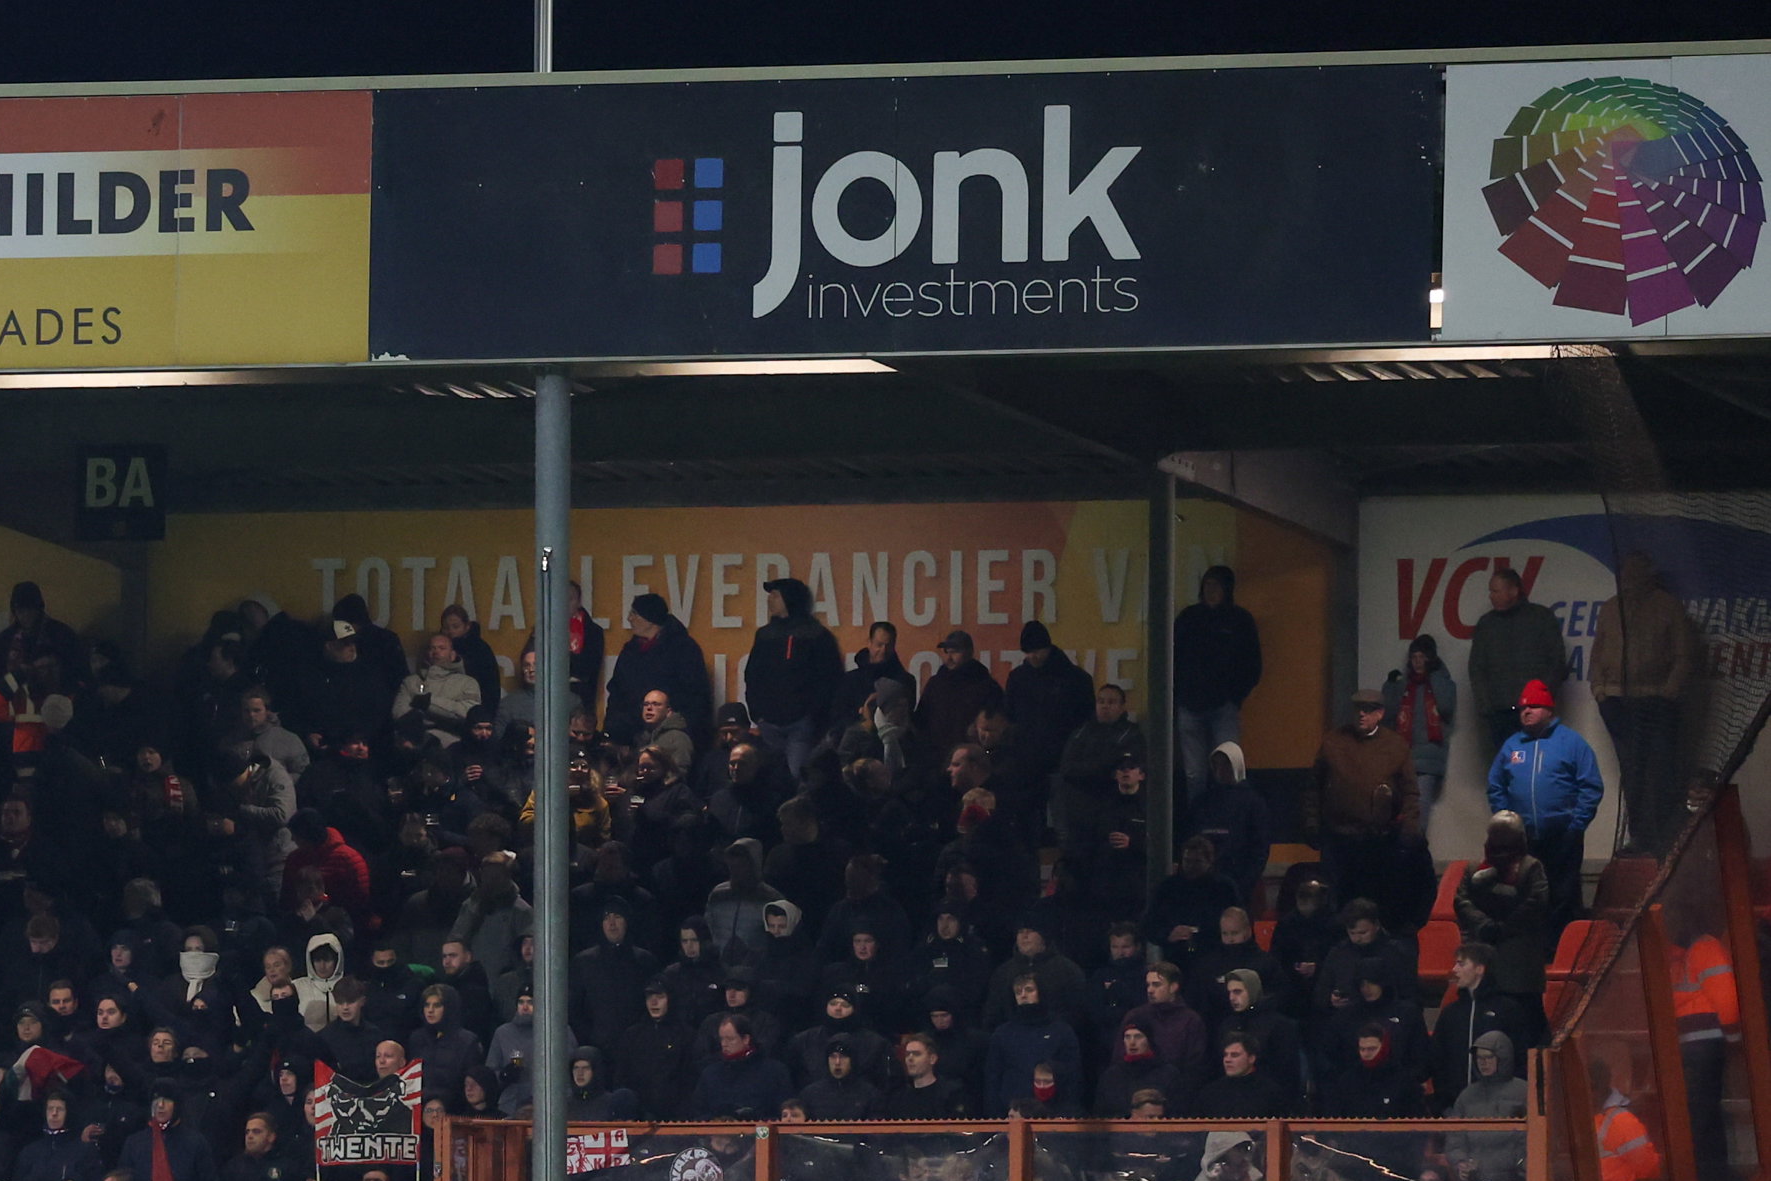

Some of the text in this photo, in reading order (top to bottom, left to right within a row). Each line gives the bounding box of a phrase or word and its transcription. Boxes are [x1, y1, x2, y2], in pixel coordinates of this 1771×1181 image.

[752, 104, 1142, 319] jonk
[806, 264, 1139, 318] investments
[85, 457, 154, 508] BA
[318, 1136, 417, 1161] TWENTE
